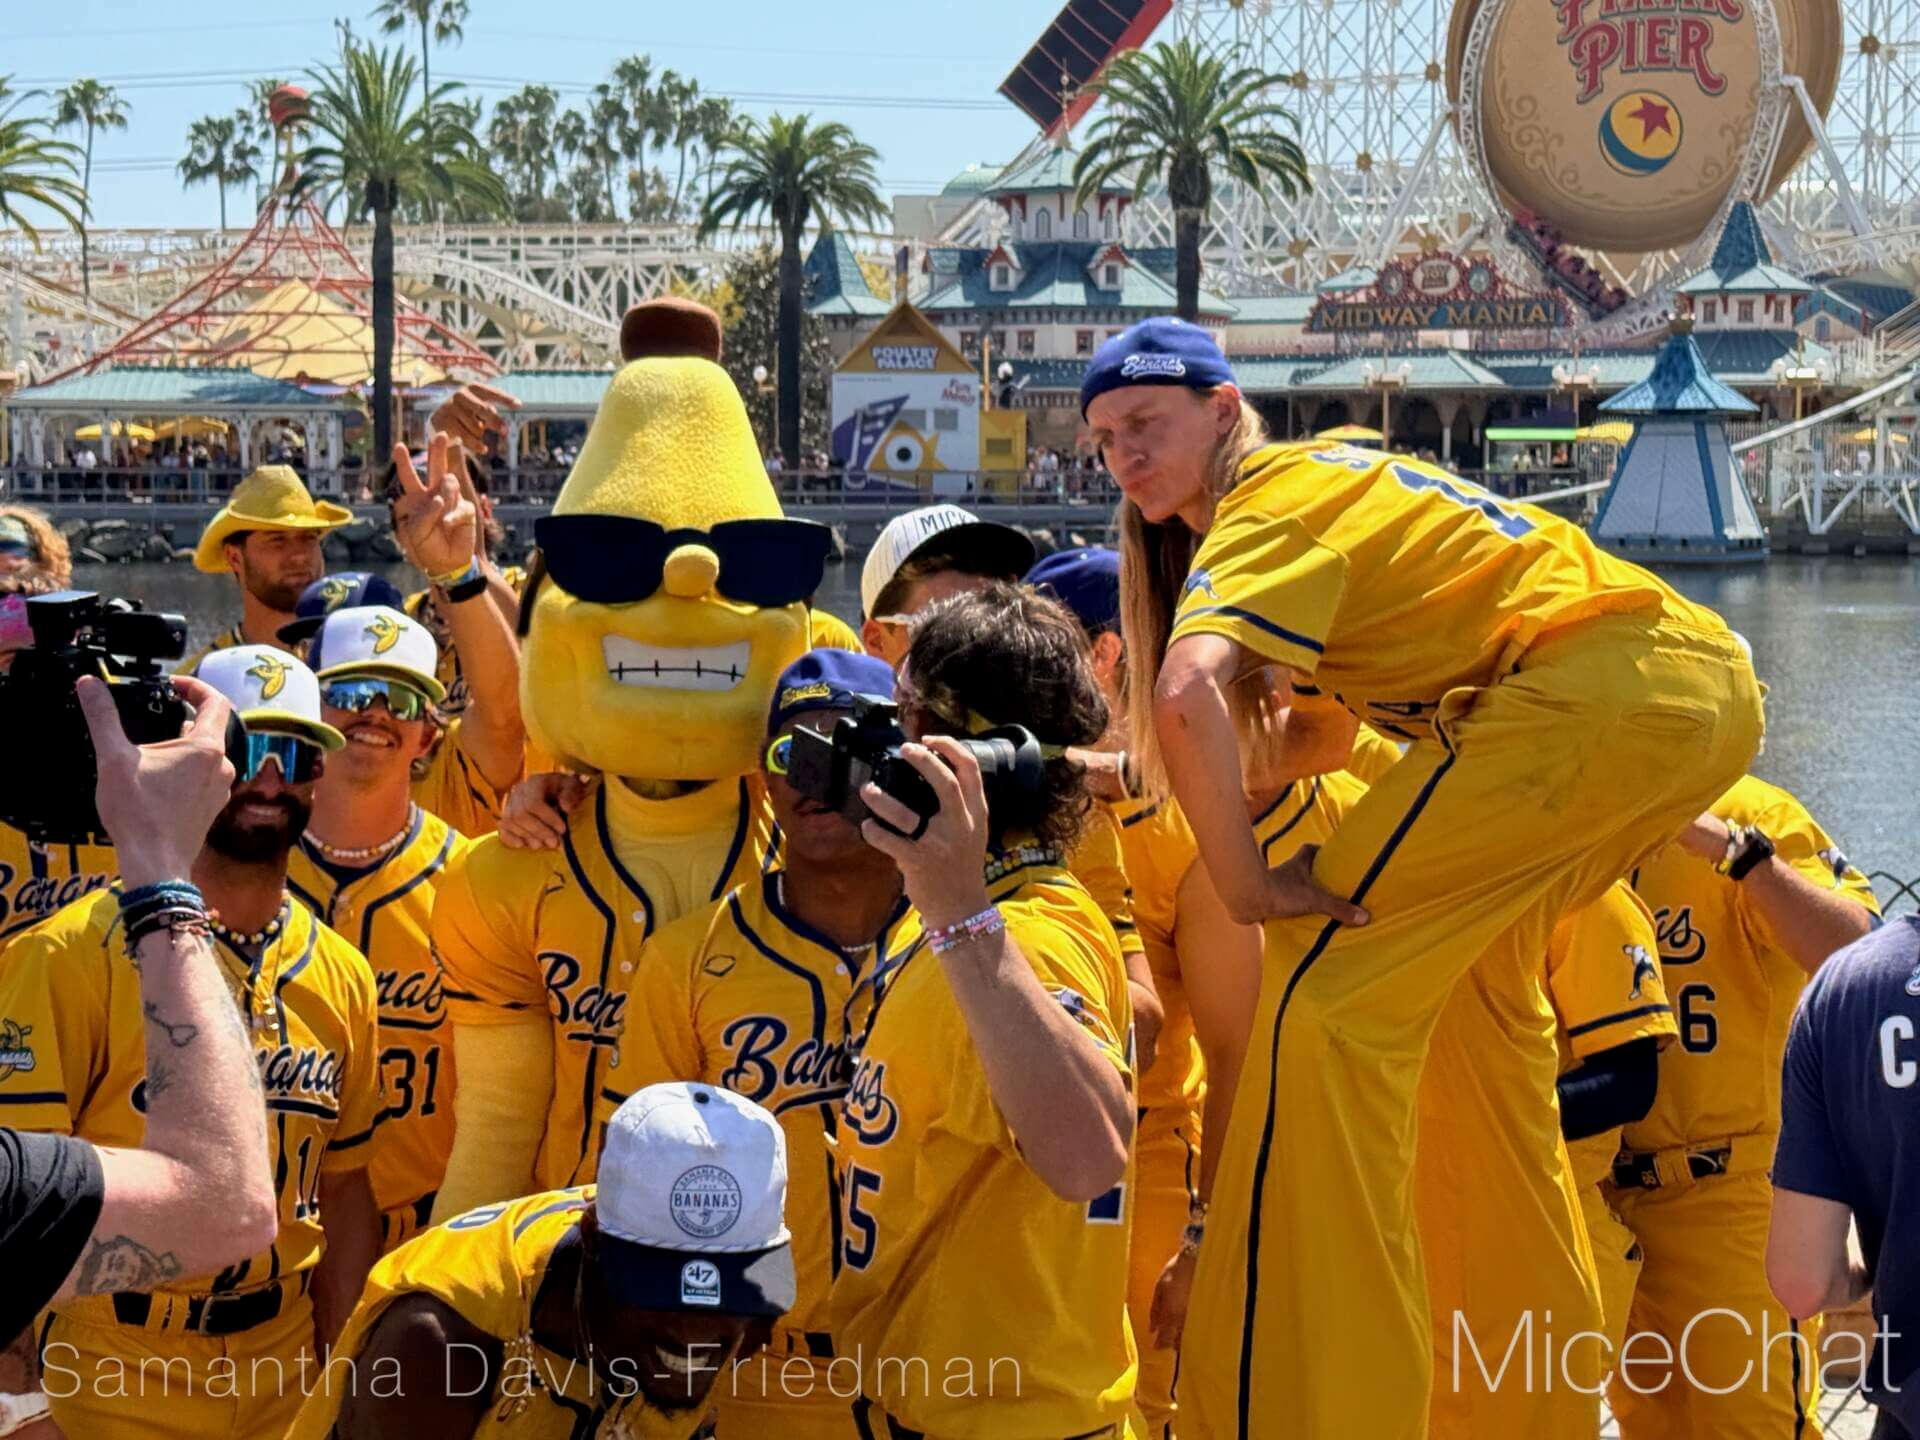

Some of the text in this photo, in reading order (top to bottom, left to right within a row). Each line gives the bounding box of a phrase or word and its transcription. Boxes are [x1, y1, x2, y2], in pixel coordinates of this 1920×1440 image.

[1570, 15, 1727, 103] PIER
[1321, 302, 1557, 328] MIDWAY MANIA!
[871, 345, 938, 360] POULTRY
[877, 358, 935, 370] PALACE
[378, 1046, 442, 1118] 31
[674, 1192, 738, 1208] BANANAS
